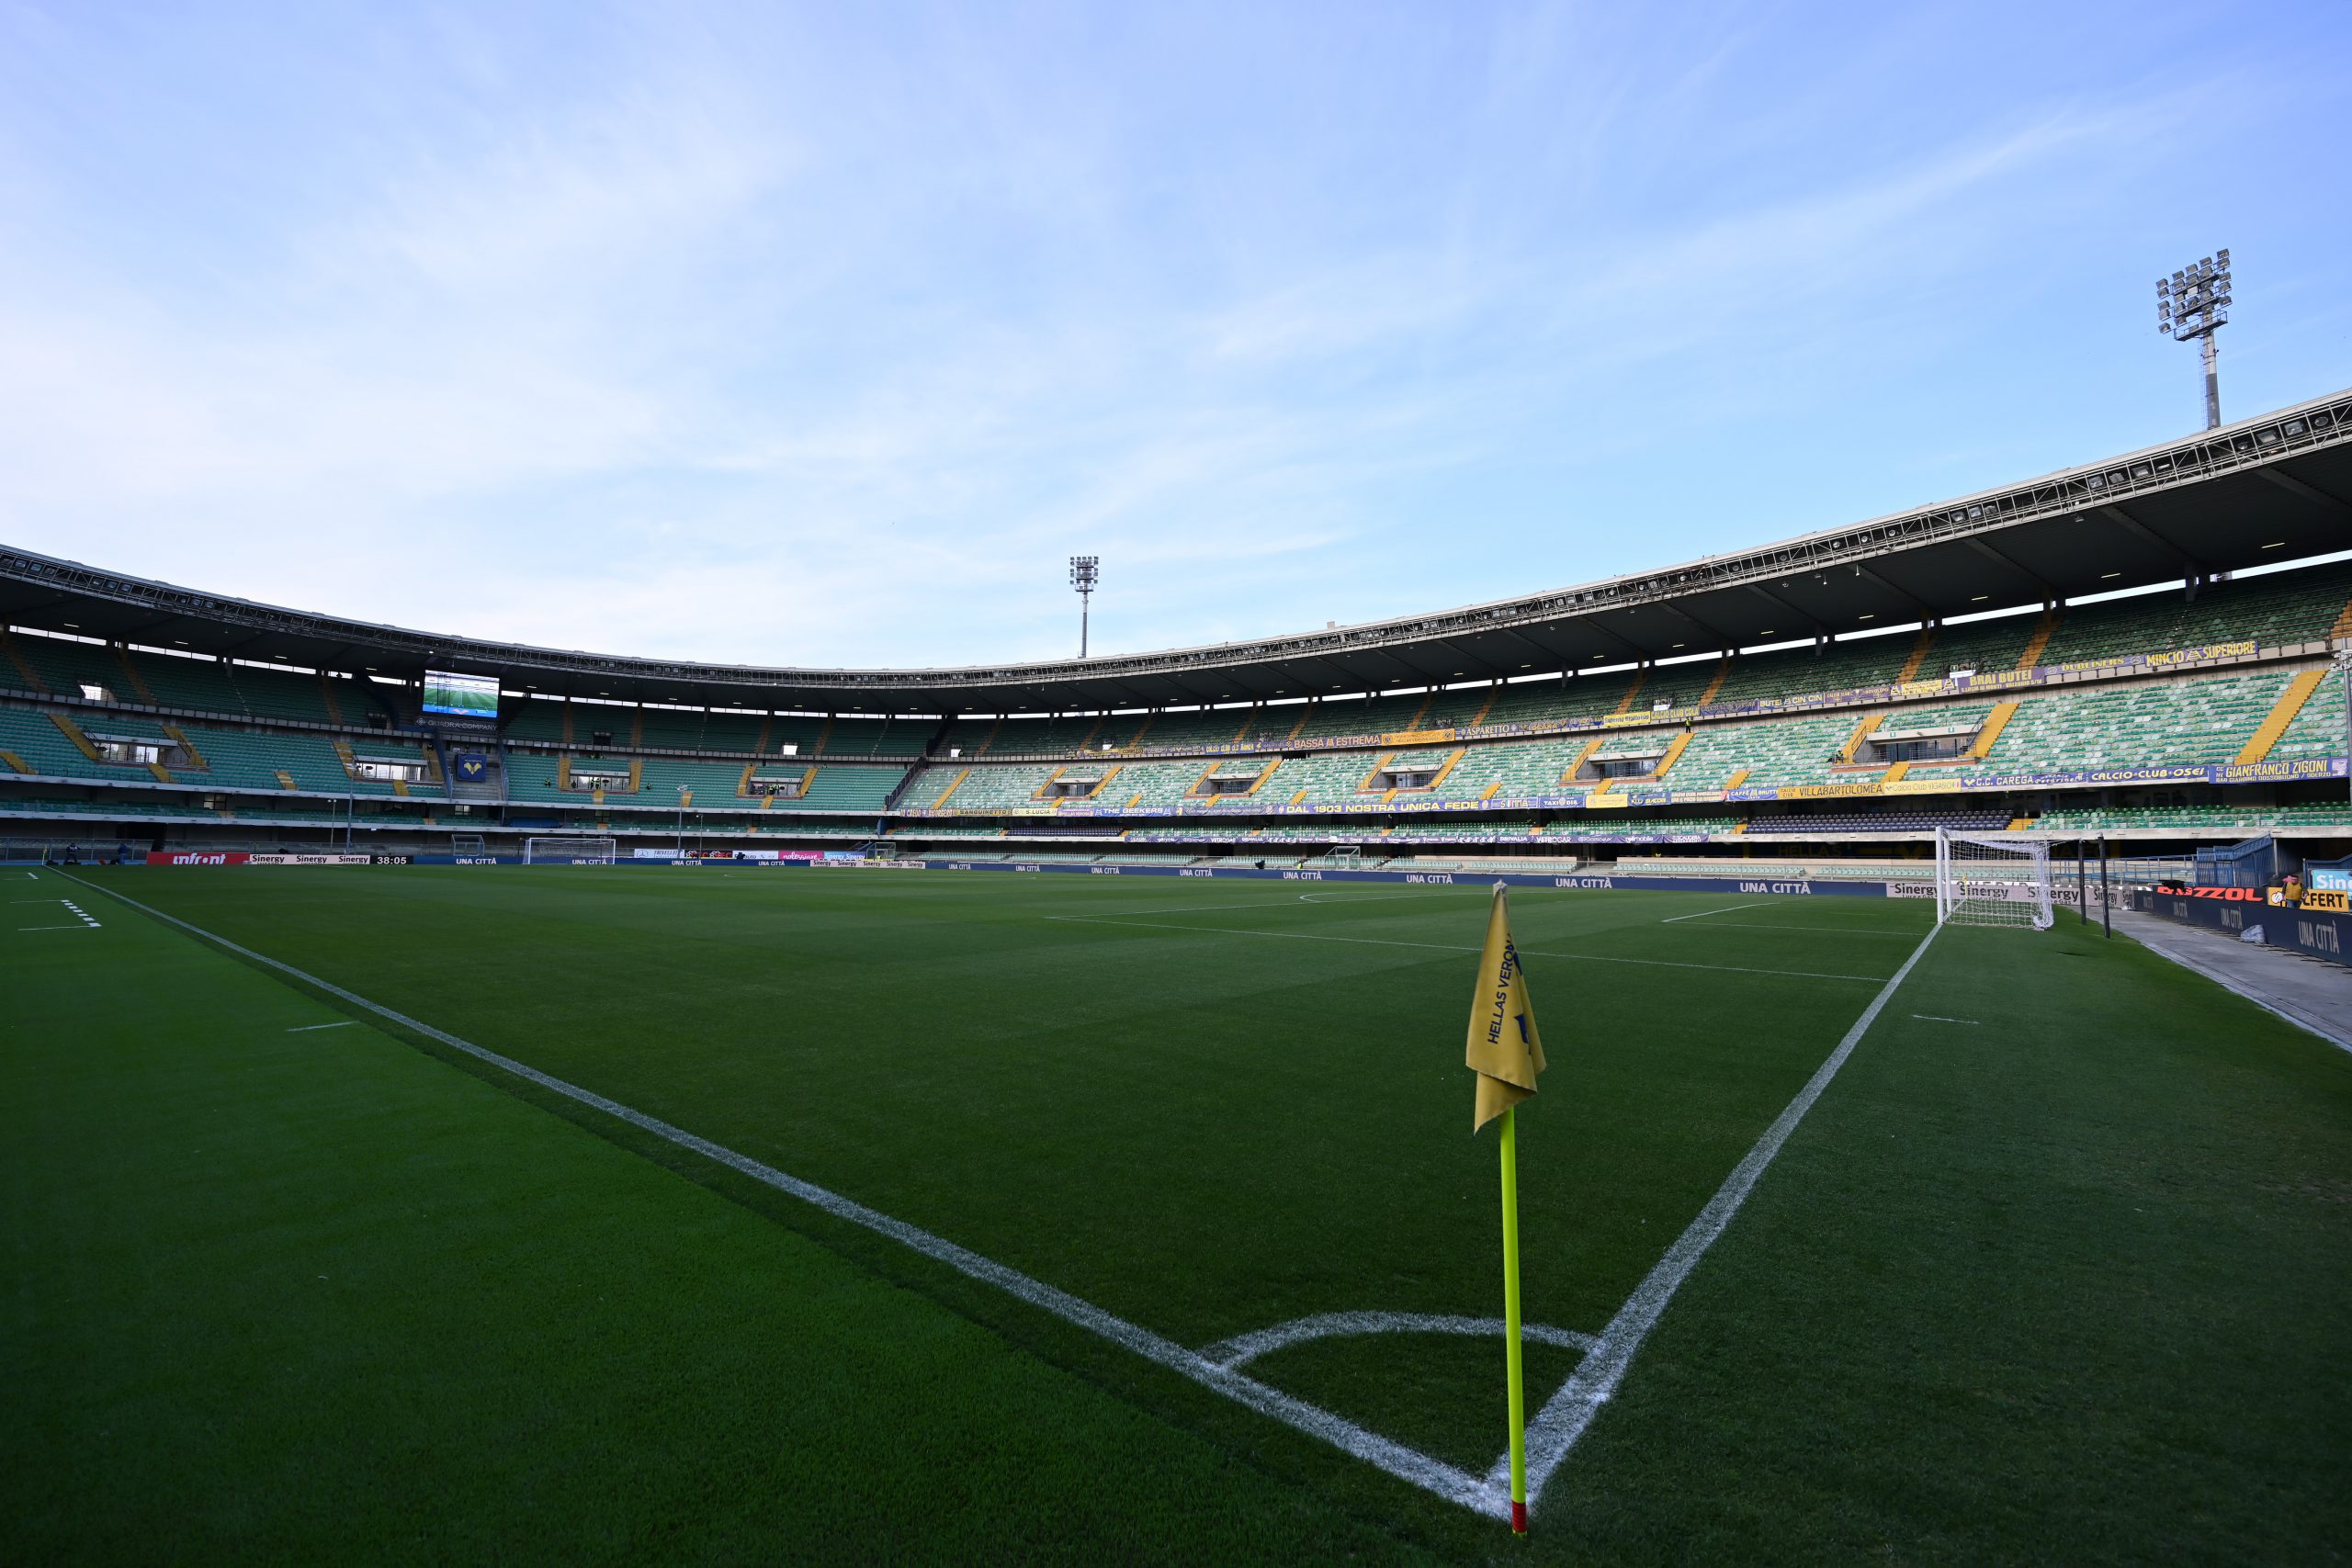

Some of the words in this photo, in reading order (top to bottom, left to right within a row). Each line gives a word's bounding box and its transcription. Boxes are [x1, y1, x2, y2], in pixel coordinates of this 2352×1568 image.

[2146, 650, 2185, 667] MINCIO
[2203, 640, 2256, 659] SUPERIORE
[2062, 659, 2125, 671] DUBLINERS
[1970, 674, 1996, 686] BRAI
[1999, 670, 2032, 682] BUTEI
[1759, 698, 1781, 707] BUTEI
[1670, 709, 1683, 718] CLUB
[428, 720, 459, 728] QUADRA
[459, 722, 498, 731] COMPANY
[1466, 725, 1510, 735] ASPARETTO
[1295, 739, 1324, 749] BASSA
[1336, 735, 1380, 746] ESTREMA
[2091, 771, 2133, 781] CALCIO
[2173, 767, 2205, 776] OSEI
[2226, 761, 2290, 778] GIANFRANCO
[2292, 759, 2328, 774] ZIGONI
[1976, 778, 1993, 786] C.C.
[1996, 775, 2033, 785] CAREGA
[1799, 784, 1883, 796] VILLABARTOLOMEA
[1313, 805, 1342, 813] 1903
[1345, 805, 1396, 813] NOSTRA
[1404, 803, 1440, 811] UNICA
[1444, 801, 1479, 809] FEDE
[173, 852, 226, 865] infront
[253, 855, 285, 863] Sinergy
[297, 855, 327, 863] Sinergy
[338, 855, 368, 863] Sinergy
[377, 856, 407, 864] 38:05
[1026, 864, 1040, 873] CITTÀ
[1104, 866, 1120, 874] CITTÀ
[1194, 868, 1213, 877] CITTÀ
[1283, 872, 1299, 880] UNA
[1300, 871, 1322, 881] CITTÀ
[1407, 874, 1425, 883] UNA
[1427, 874, 1453, 885] CITTÀ
[1555, 878, 1577, 888] UNA
[1581, 876, 1612, 889] CITTÀ
[1739, 882, 1769, 894] UNA
[1772, 881, 1812, 895] CITTÀ
[1960, 886, 2009, 899] Sinergy
[2221, 907, 2231, 927] UNA
[2298, 920, 2314, 948] UNA
[2315, 919, 2340, 954] CITTÀ
[1487, 991, 1507, 1045] HELLAS
[1498, 933, 1516, 988] VERON
